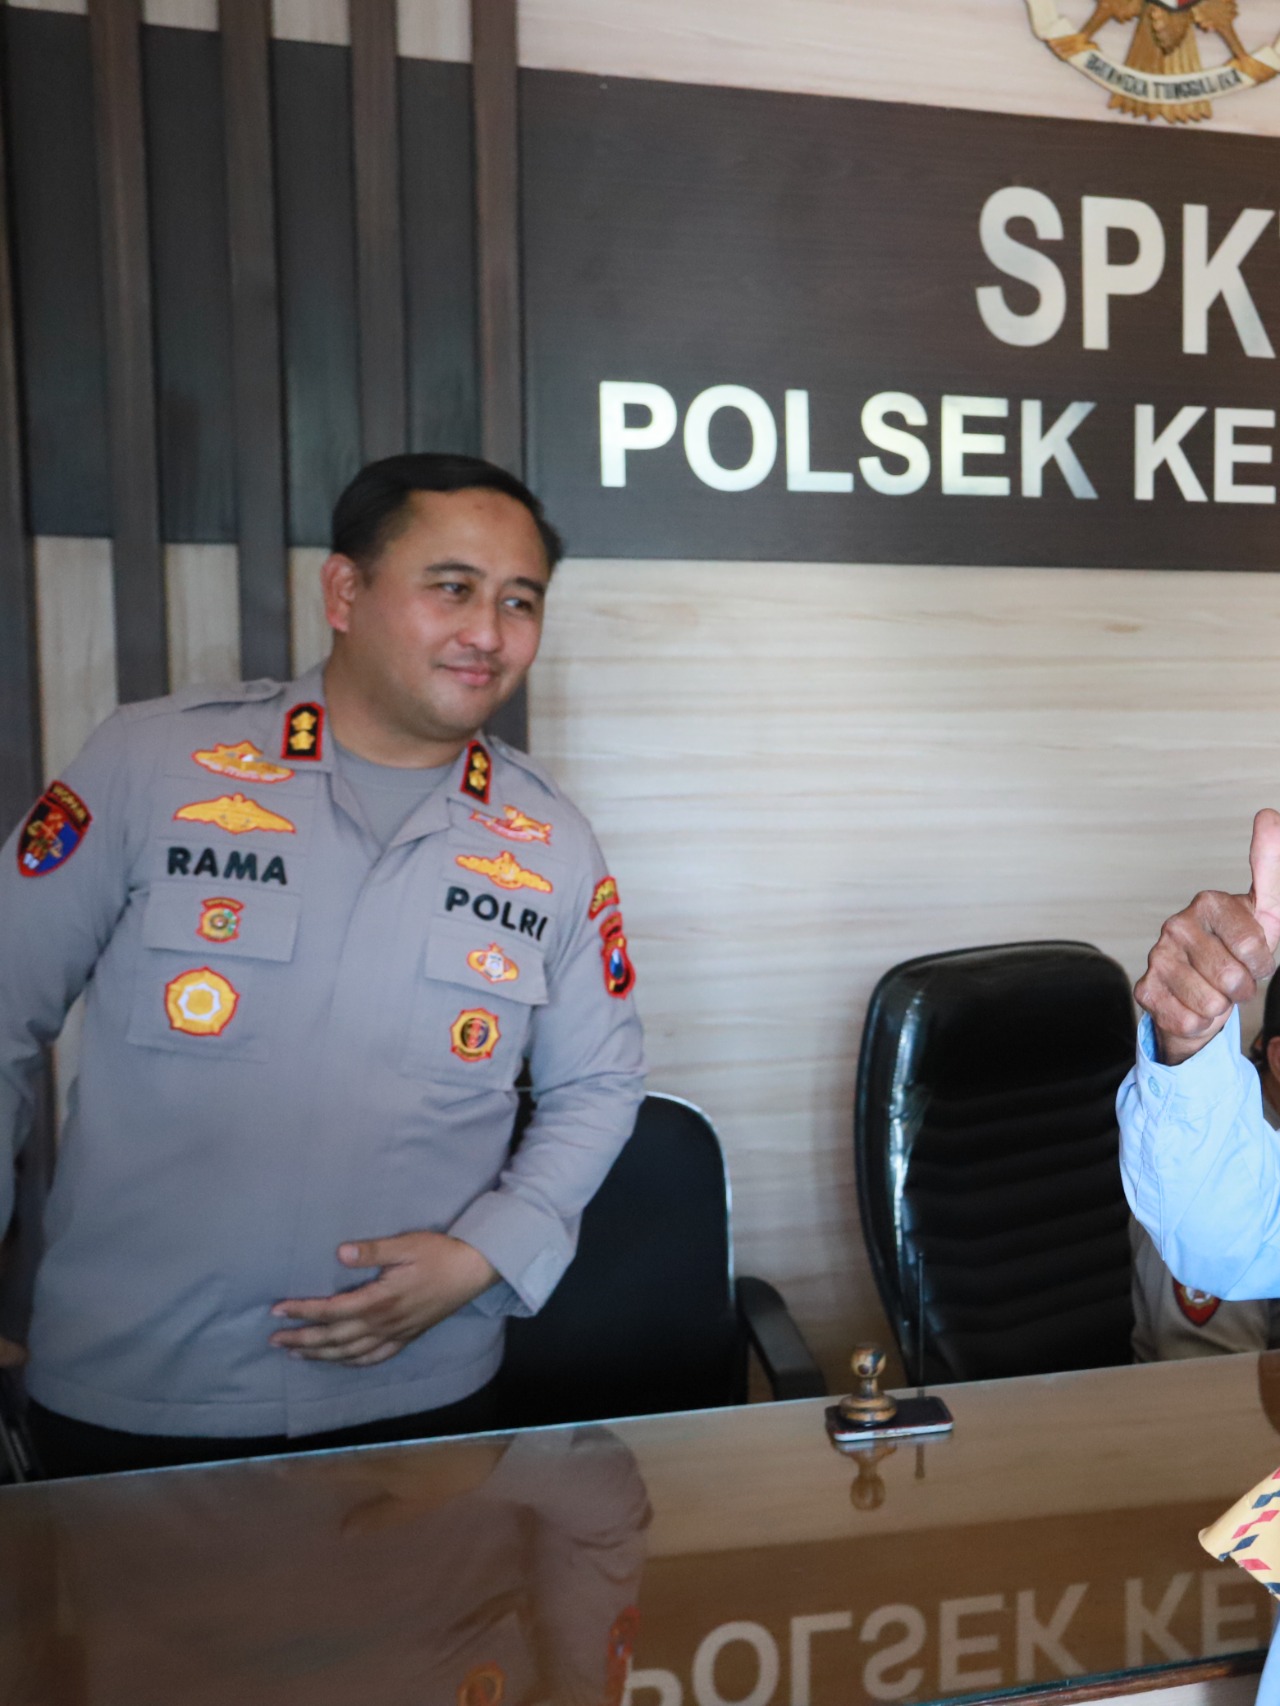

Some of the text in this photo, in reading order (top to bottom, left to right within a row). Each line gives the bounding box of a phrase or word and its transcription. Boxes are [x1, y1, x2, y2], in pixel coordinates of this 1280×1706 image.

[599, 380, 1099, 501] POLSEK
[167, 846, 288, 885] RAMA
[445, 886, 548, 941] POLRI
